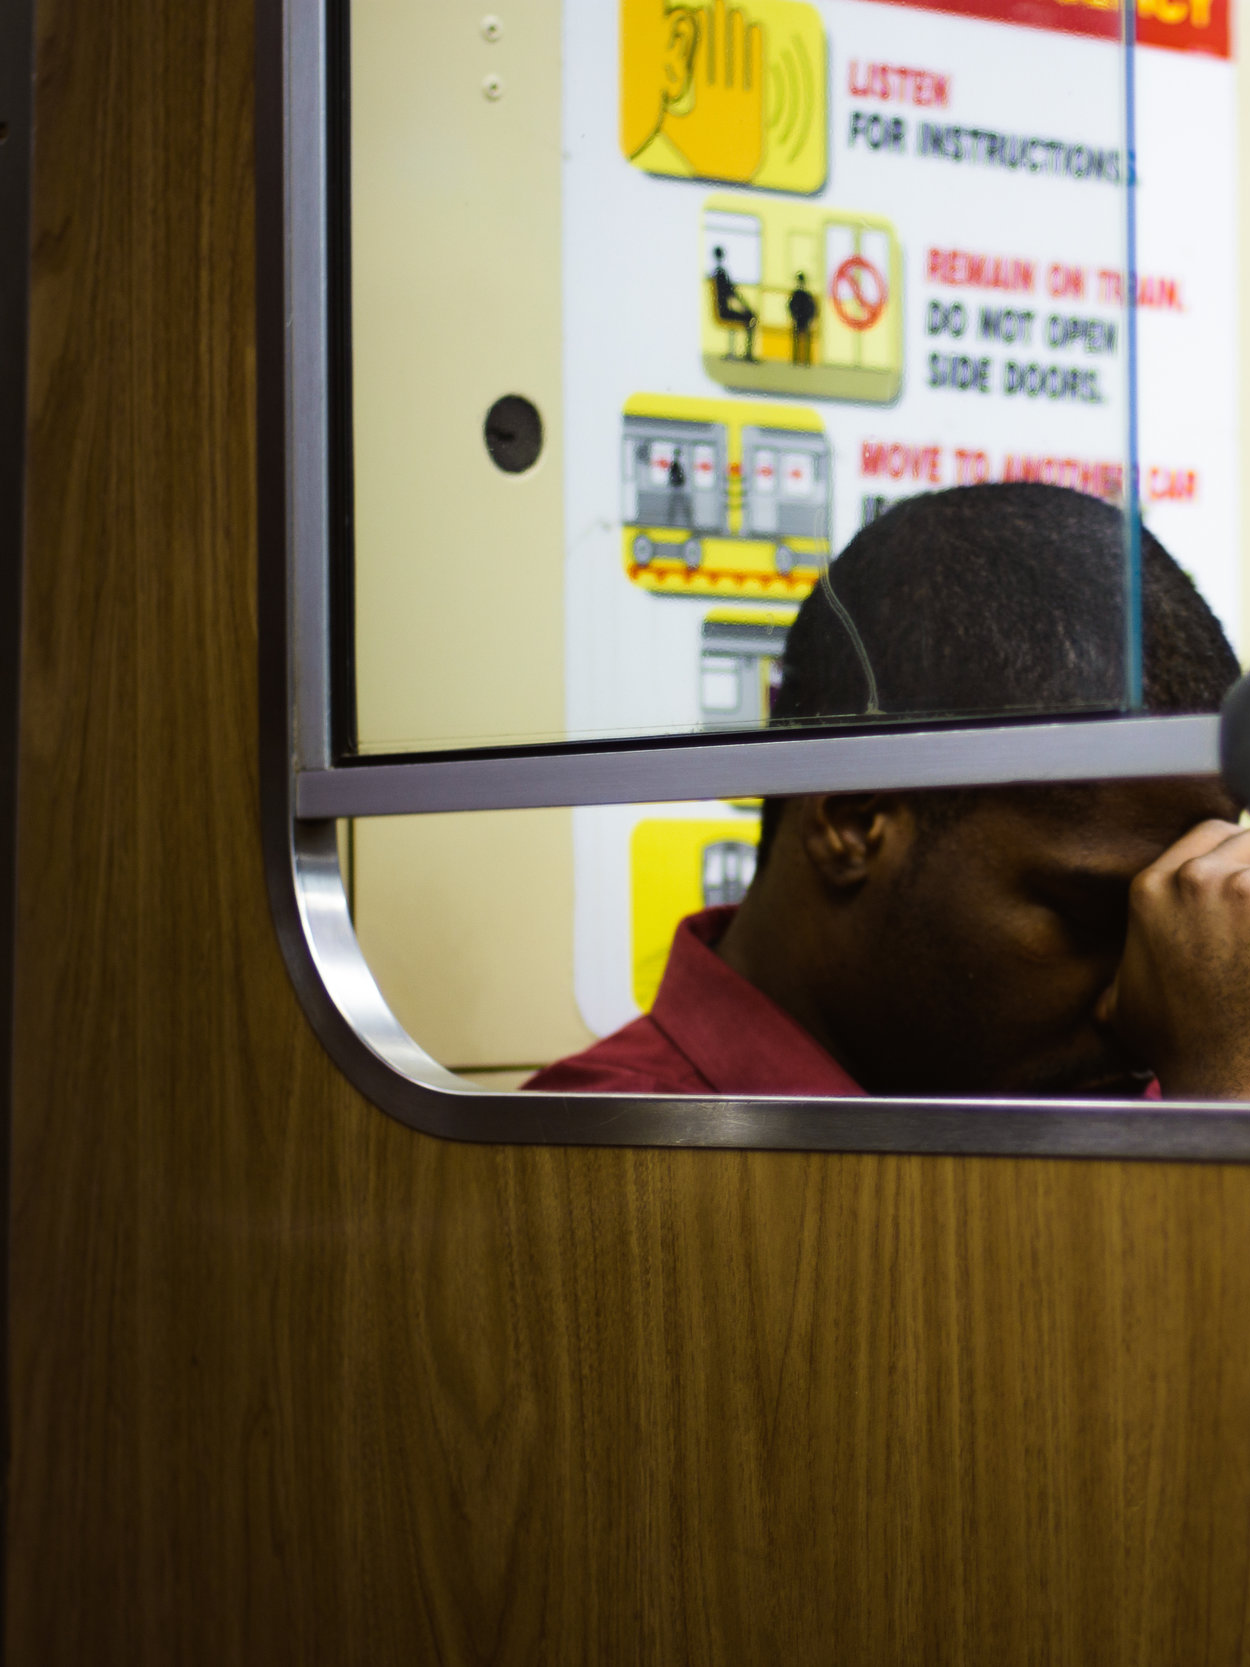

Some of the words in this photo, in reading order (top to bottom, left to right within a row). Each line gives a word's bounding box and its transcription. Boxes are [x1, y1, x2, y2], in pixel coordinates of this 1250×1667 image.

[848, 60, 950, 108] LISTEN
[848, 110, 906, 151] FOR
[927, 248, 1036, 293] REMAIN
[1048, 262, 1085, 298] ON
[928, 300, 966, 338] DO
[978, 305, 1035, 344] NOT
[1045, 314, 1118, 355] OPEN
[929, 351, 990, 393] SIDE
[1004, 360, 1105, 404] DOORS.
[861, 440, 941, 483] MOVE
[954, 447, 989, 485] TO
[1148, 464, 1197, 501] CAR
